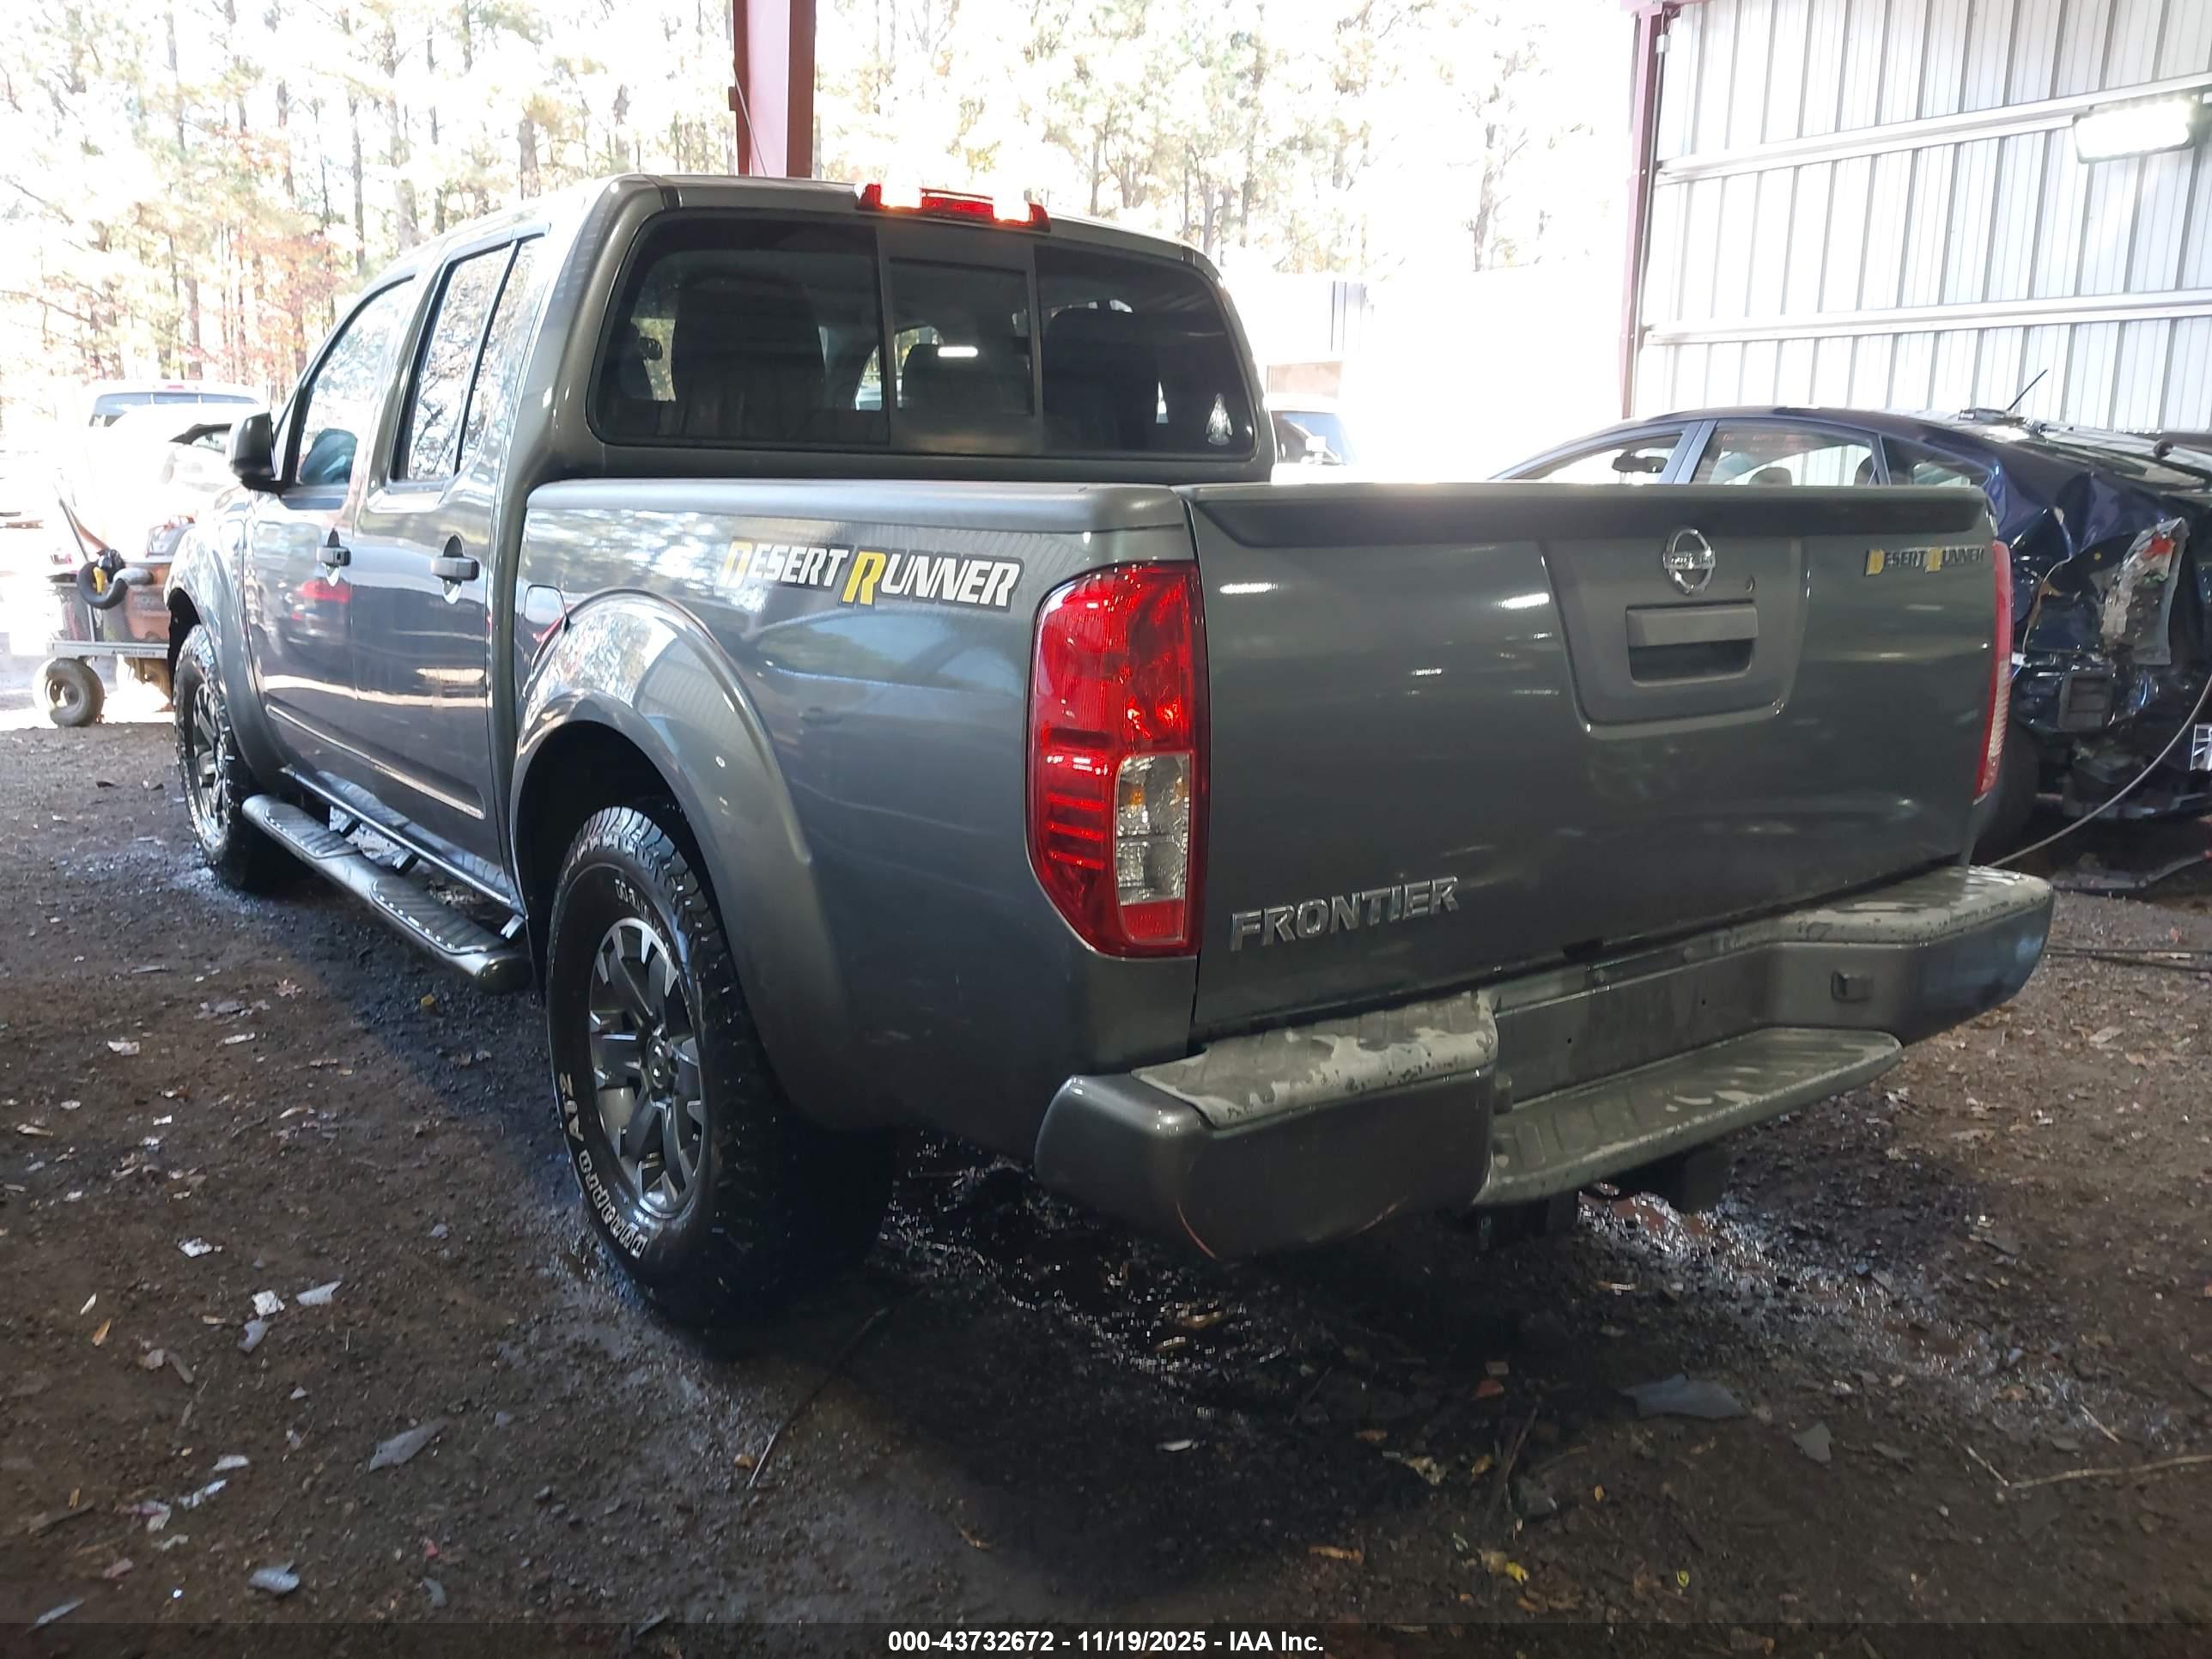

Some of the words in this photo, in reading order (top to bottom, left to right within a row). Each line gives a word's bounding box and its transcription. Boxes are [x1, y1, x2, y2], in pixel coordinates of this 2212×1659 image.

[716, 540, 849, 589] DESERT
[842, 550, 1021, 606] RUNNER
[1230, 875, 1461, 952] FRONTIER
